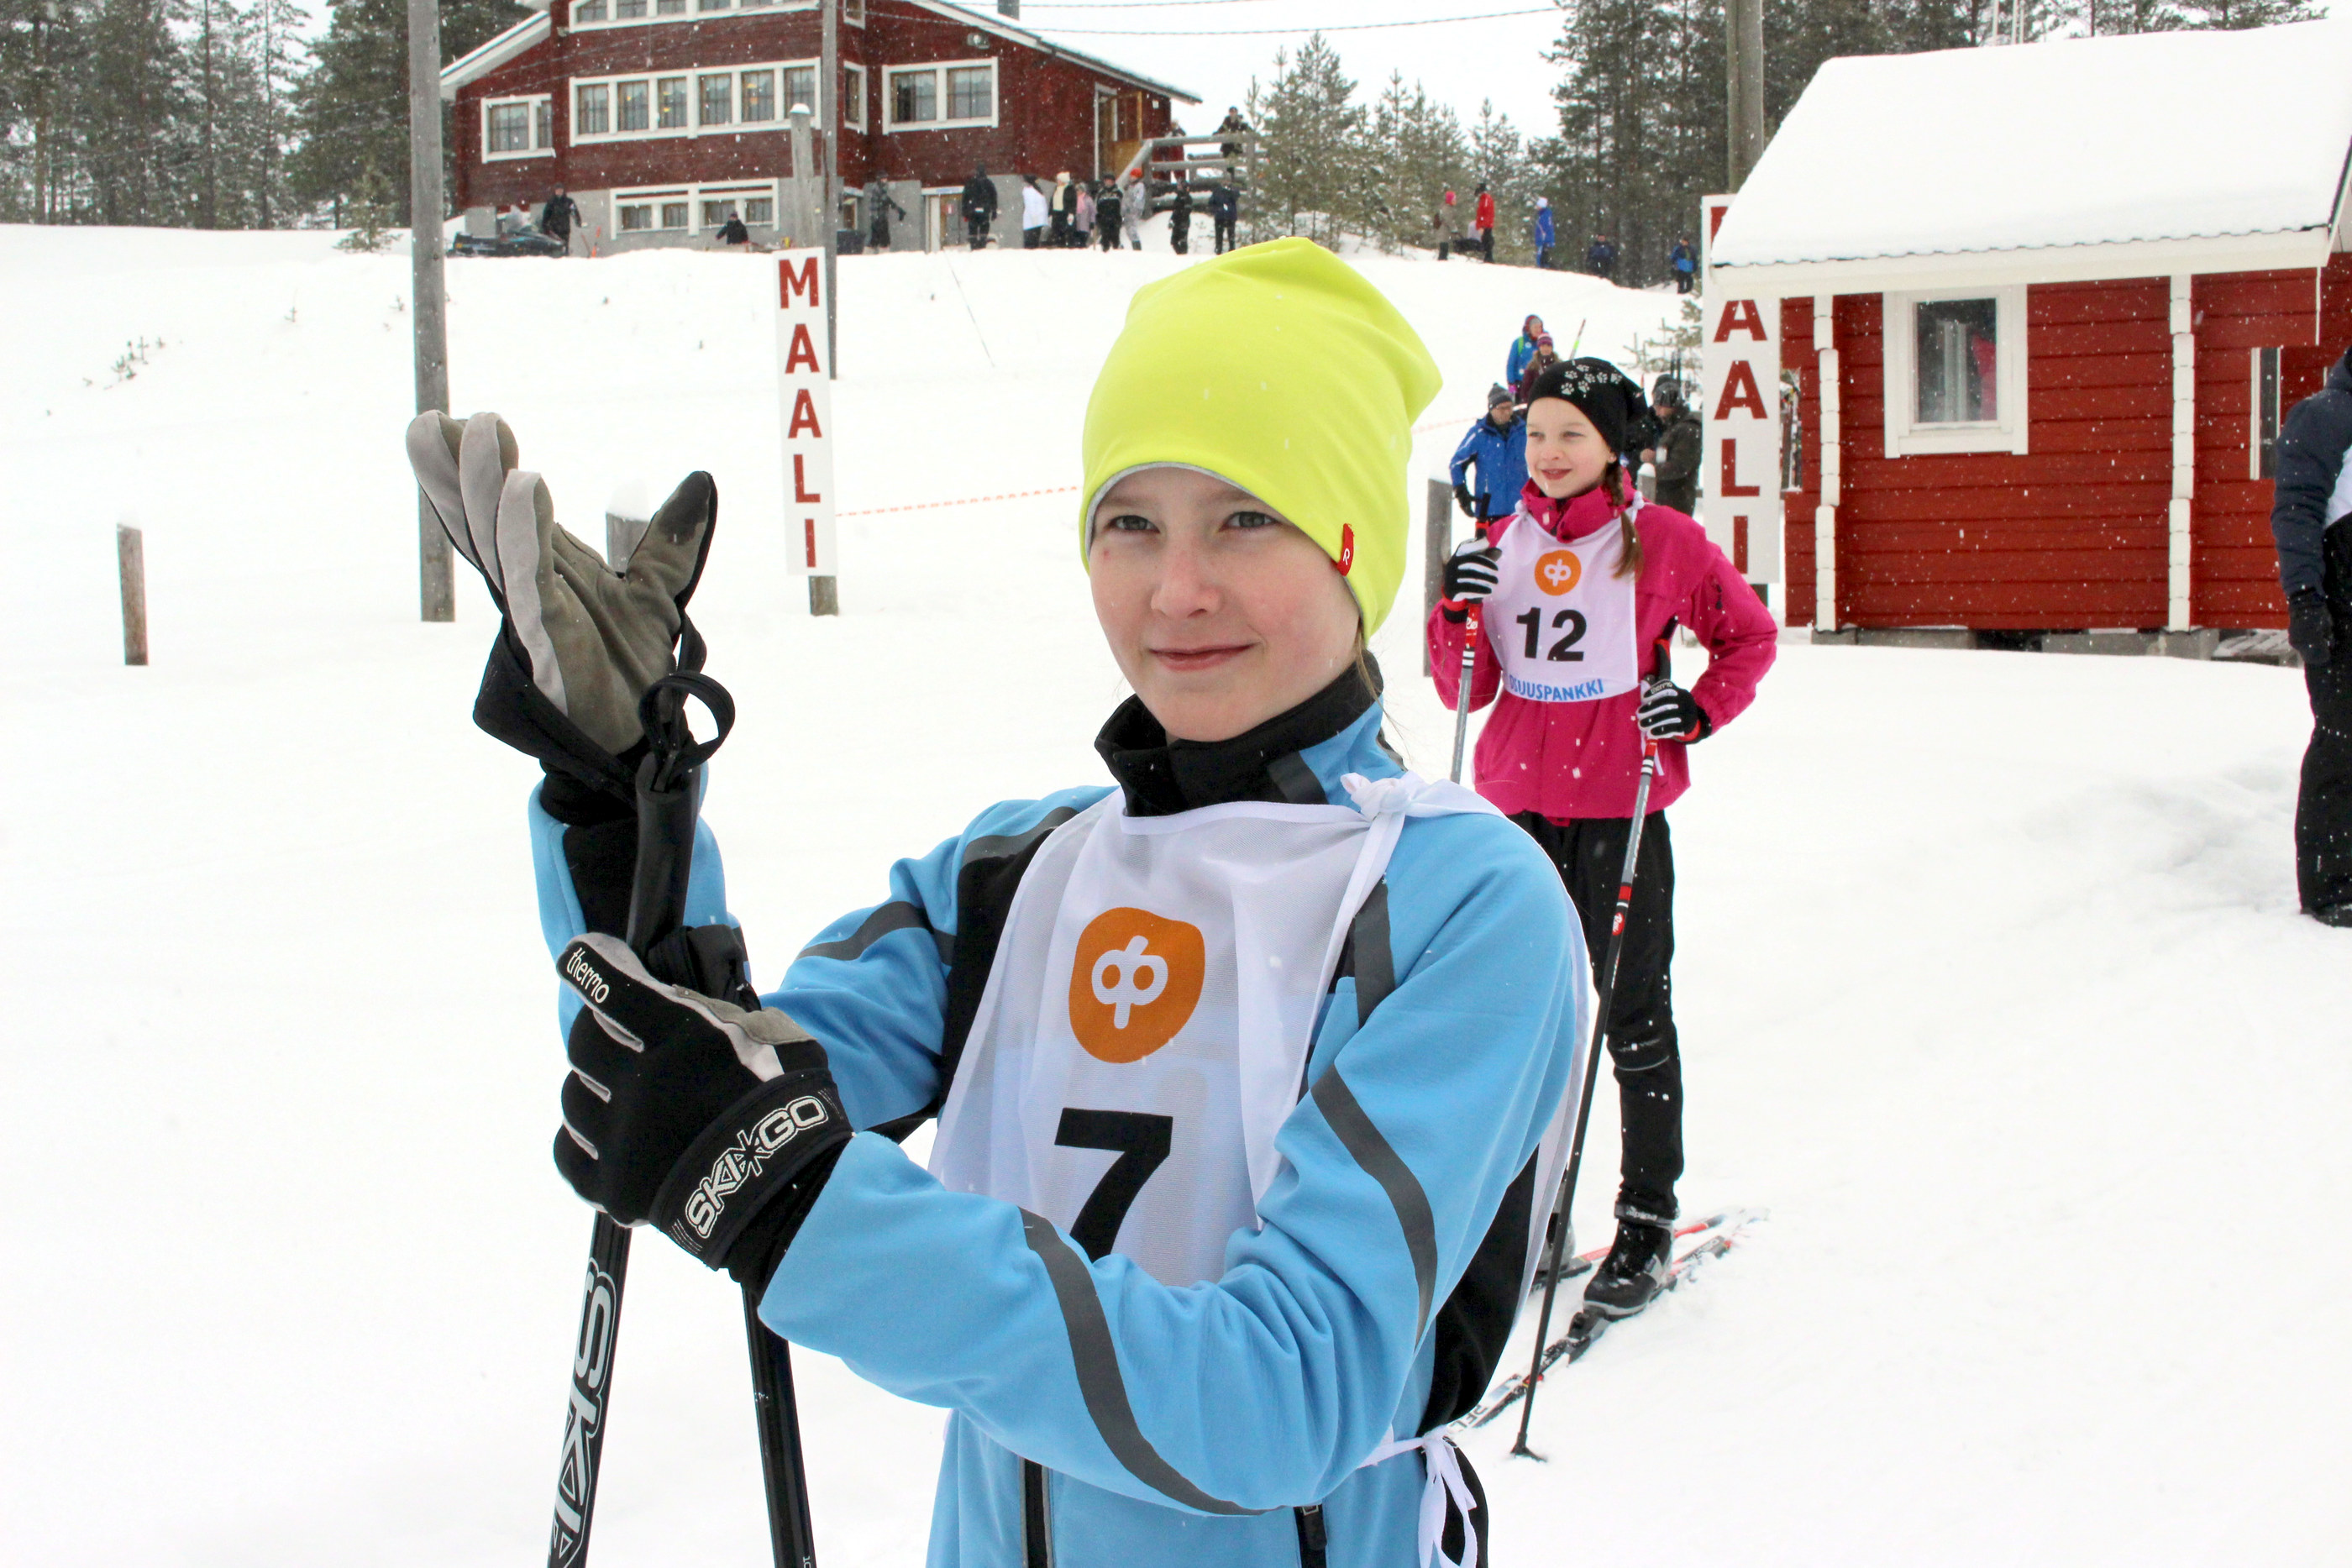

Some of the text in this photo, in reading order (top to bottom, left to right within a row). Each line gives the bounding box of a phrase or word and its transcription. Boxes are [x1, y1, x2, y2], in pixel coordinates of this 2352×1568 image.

[779, 255, 822, 568] MAALI
[1516, 606, 1588, 662] 12
[566, 947, 611, 1004] thermo
[1055, 1107, 1173, 1265] 7
